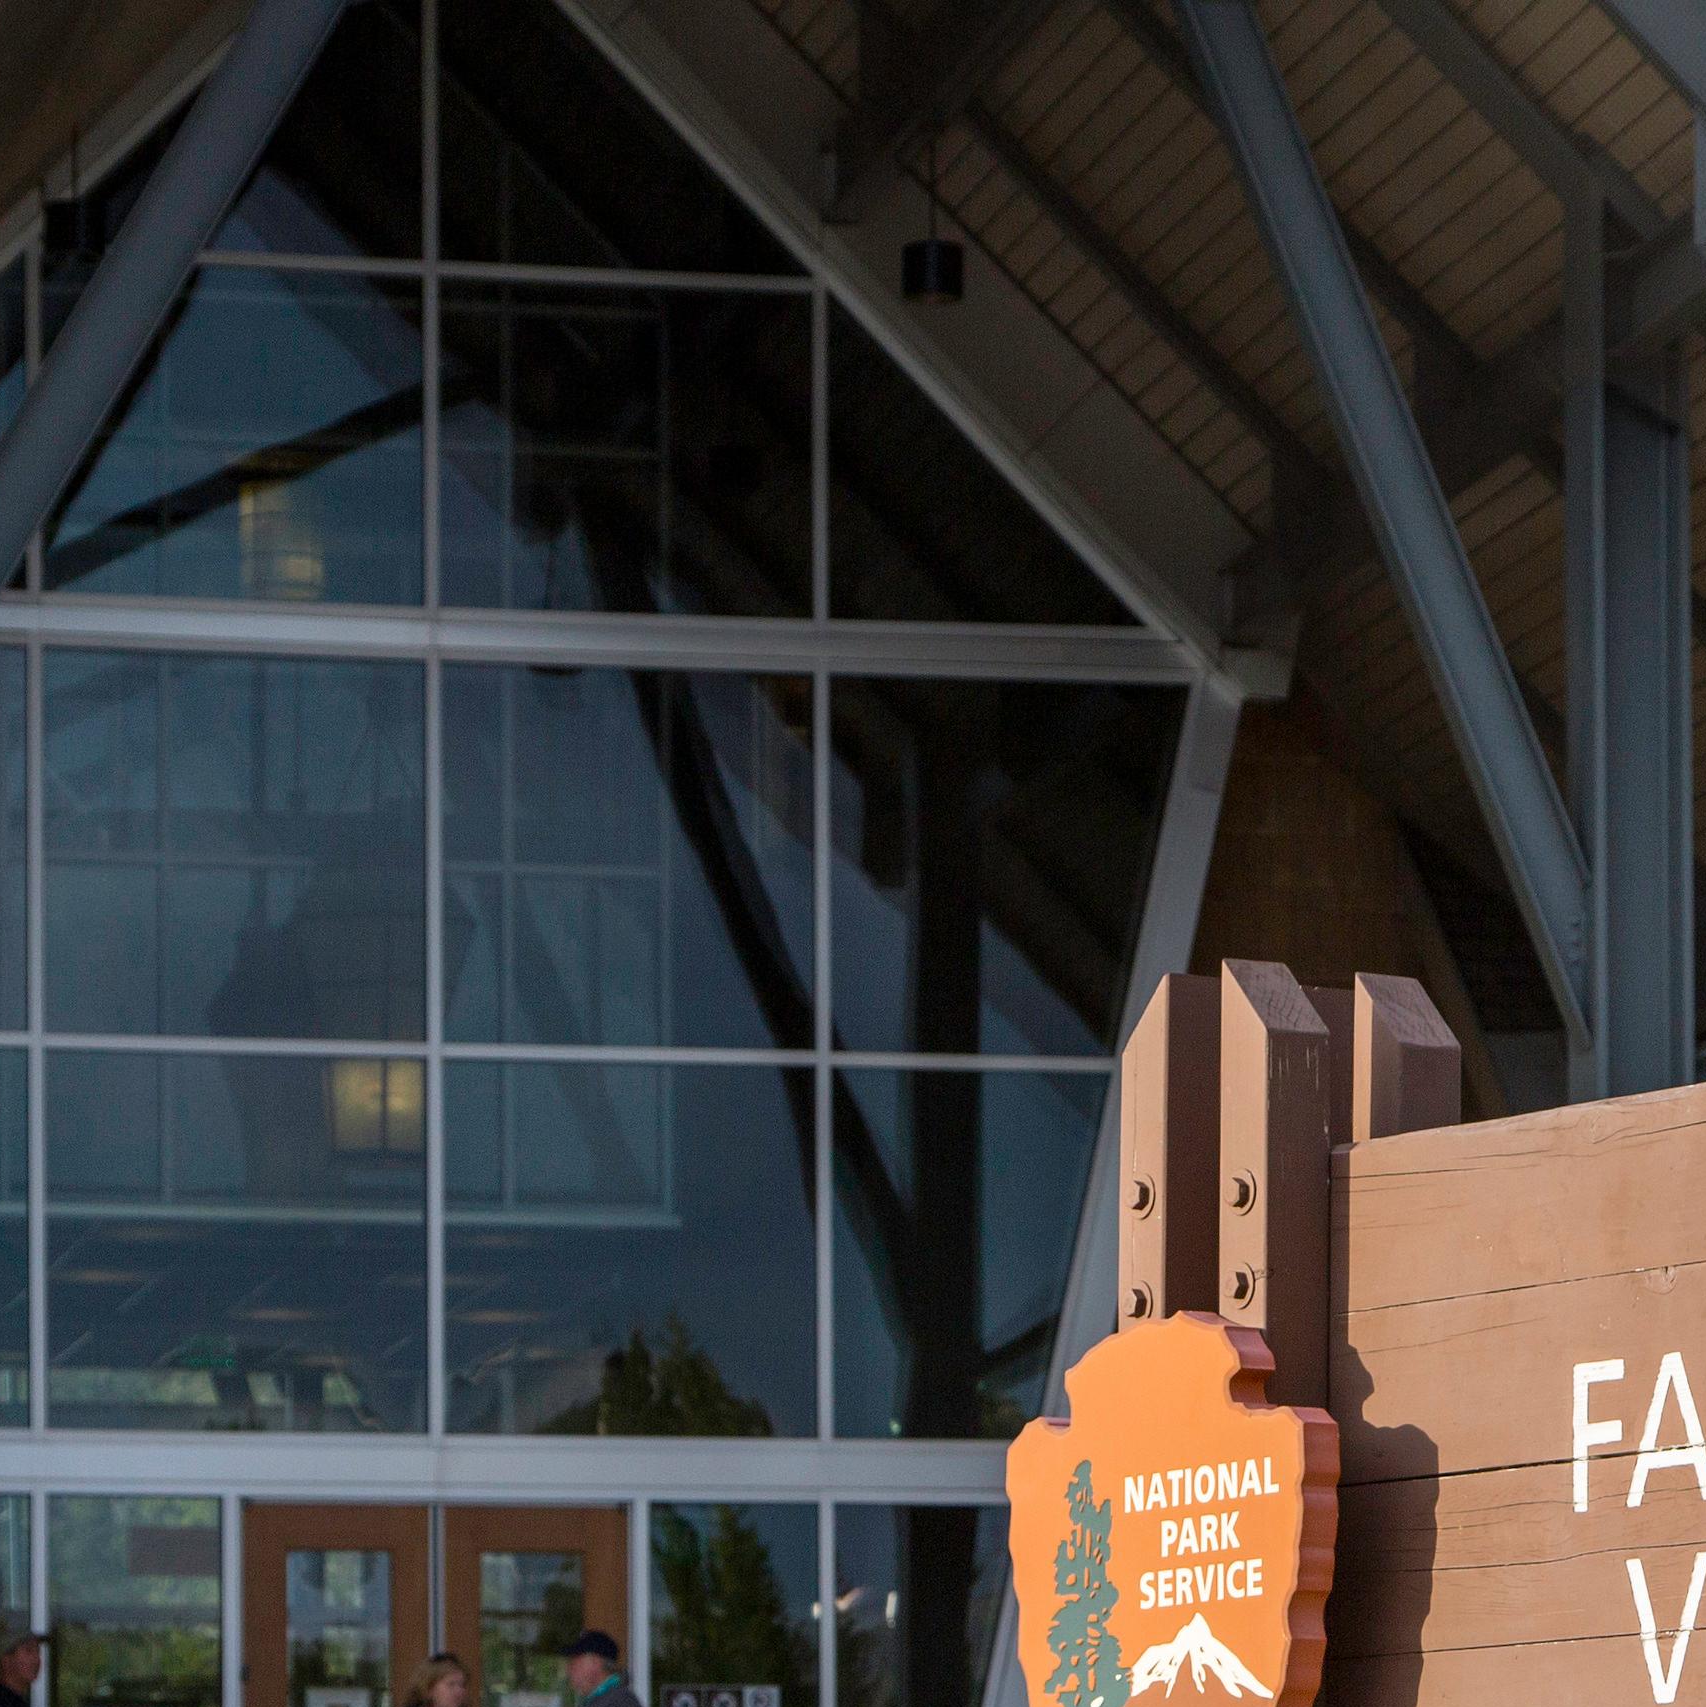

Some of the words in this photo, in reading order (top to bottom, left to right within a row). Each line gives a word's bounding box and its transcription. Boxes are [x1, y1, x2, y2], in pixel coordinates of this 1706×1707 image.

[1123, 1456, 1280, 1513] NATIONAL
[1160, 1511, 1241, 1558] PARK
[1138, 1557, 1264, 1610] SERVICE
